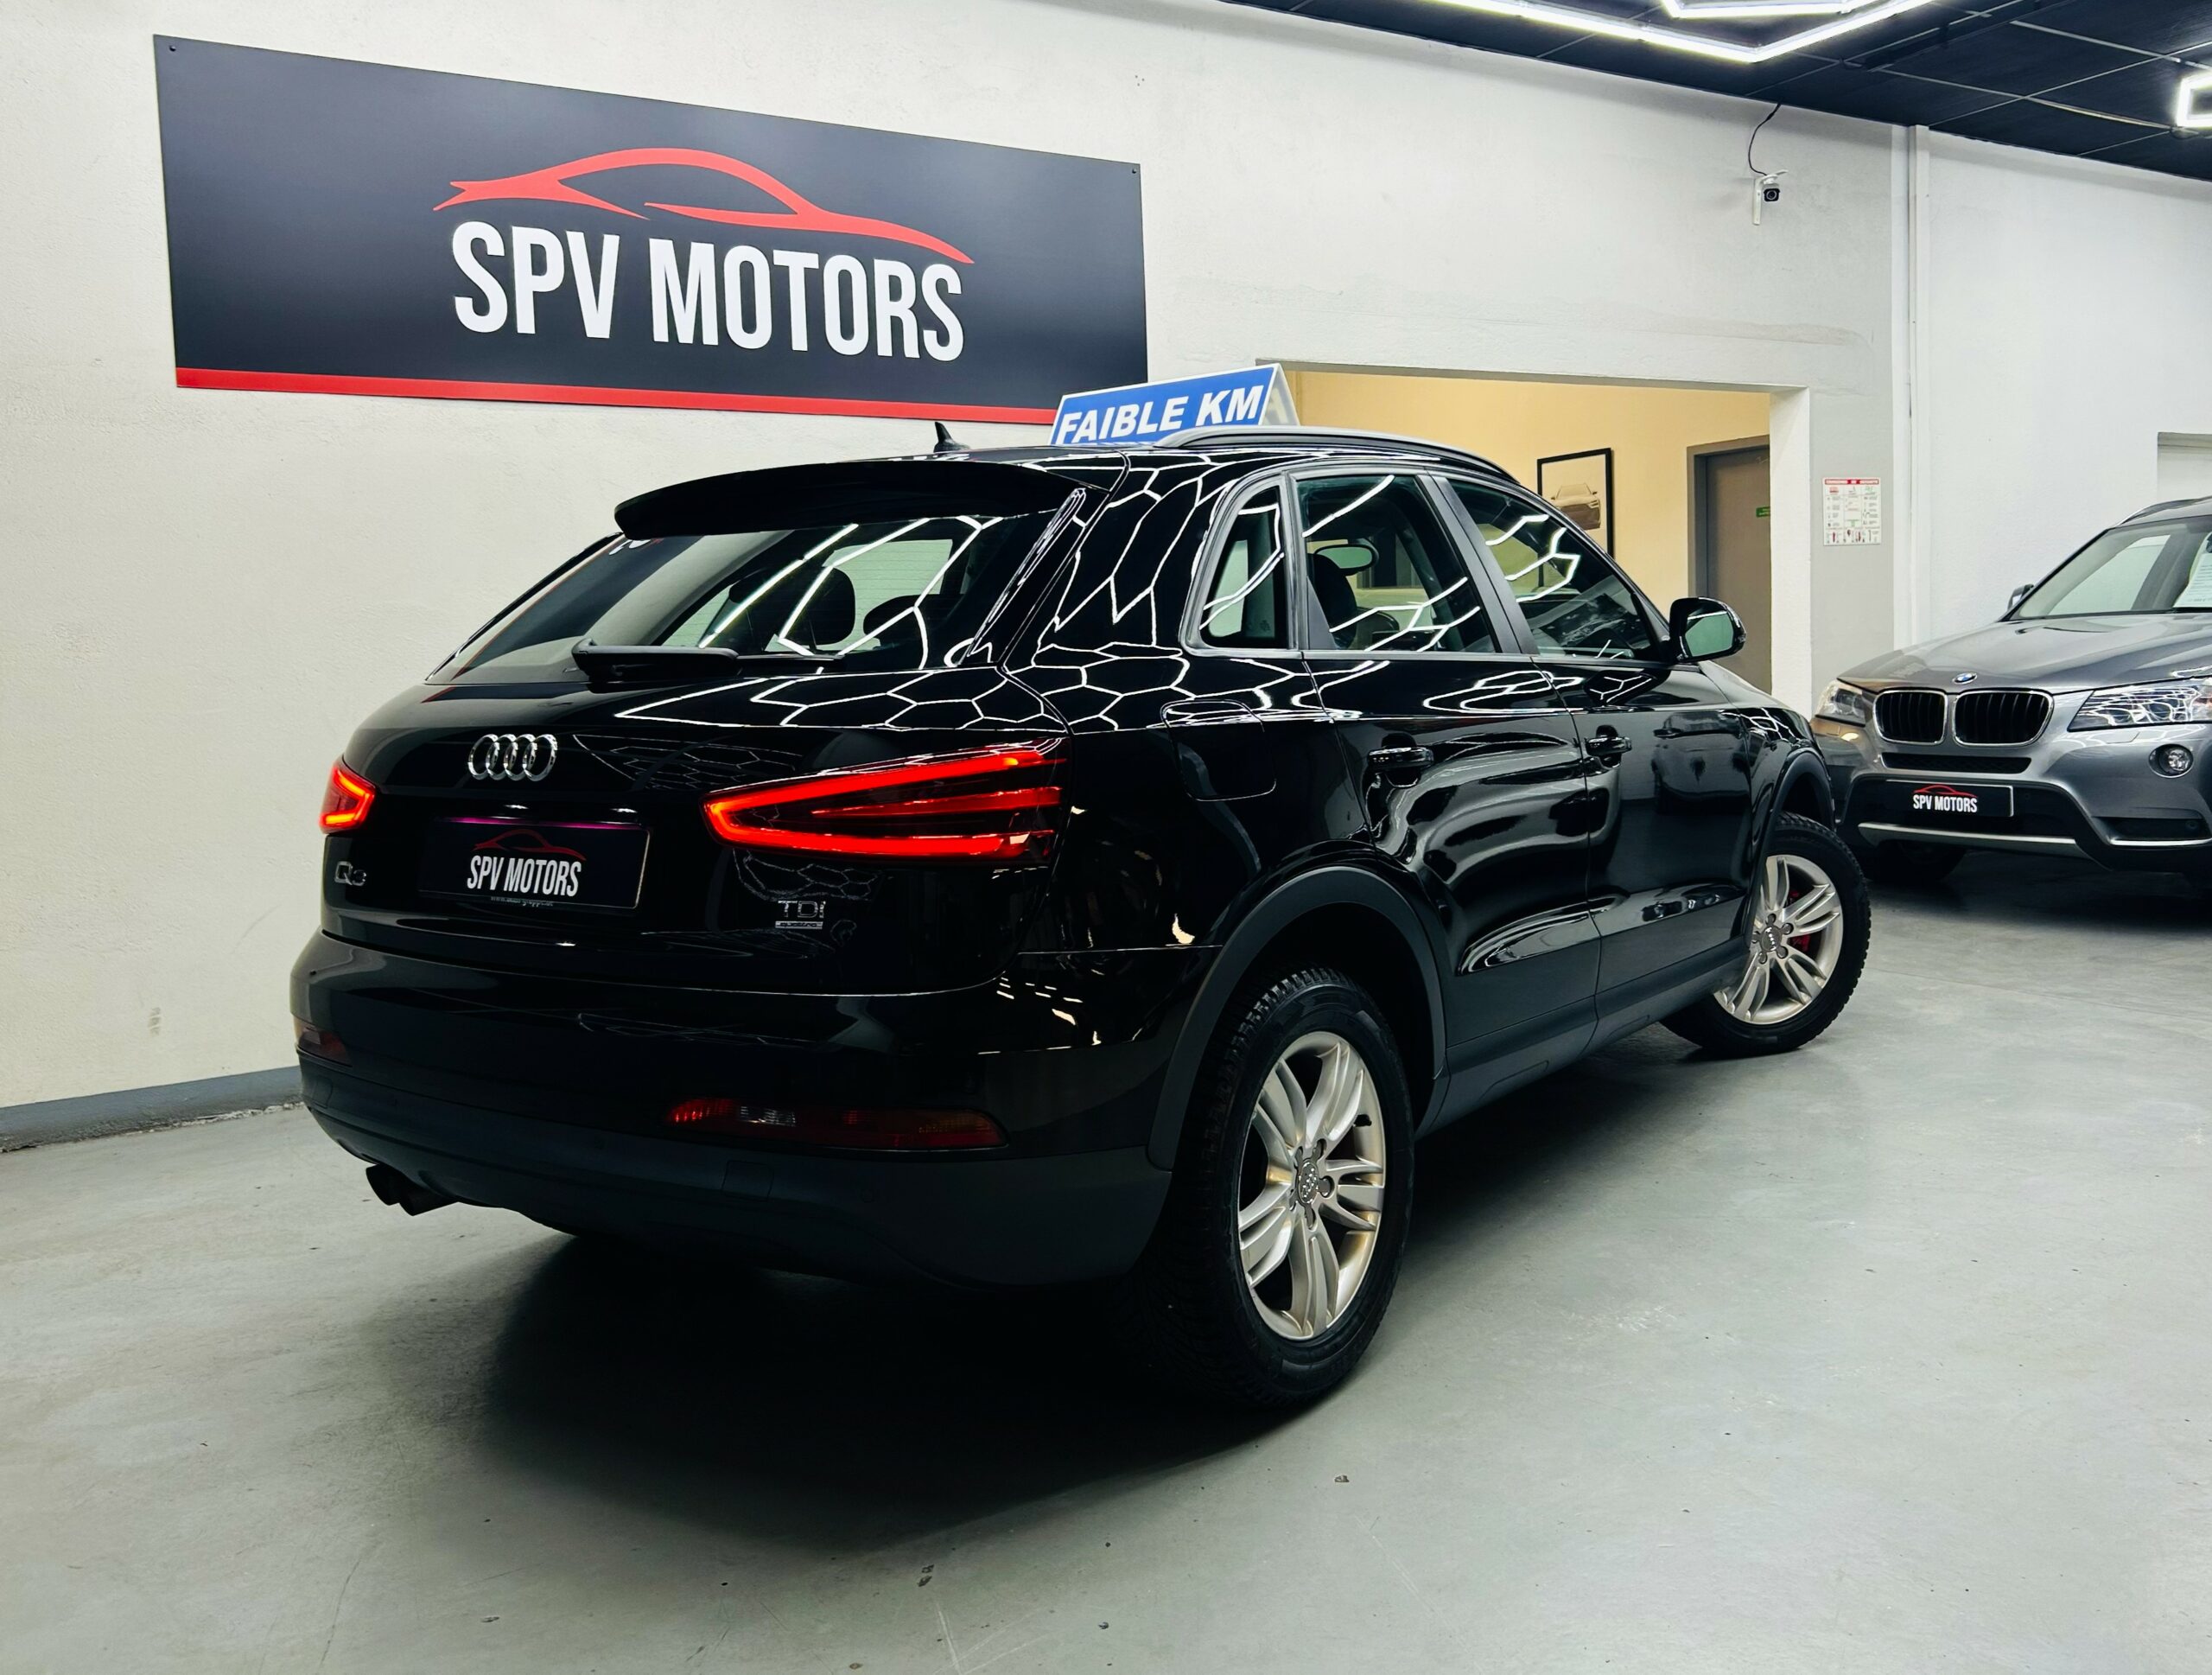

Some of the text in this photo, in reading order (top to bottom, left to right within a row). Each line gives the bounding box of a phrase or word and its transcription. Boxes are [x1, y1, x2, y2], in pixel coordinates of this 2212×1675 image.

[452, 220, 965, 362] SPV MOTORS
[1055, 385, 1264, 444] FAIBLE KM
[1912, 793, 1978, 813] SPV MOTORS
[334, 861, 367, 887] Q3
[467, 855, 582, 897] SPV MOTORS
